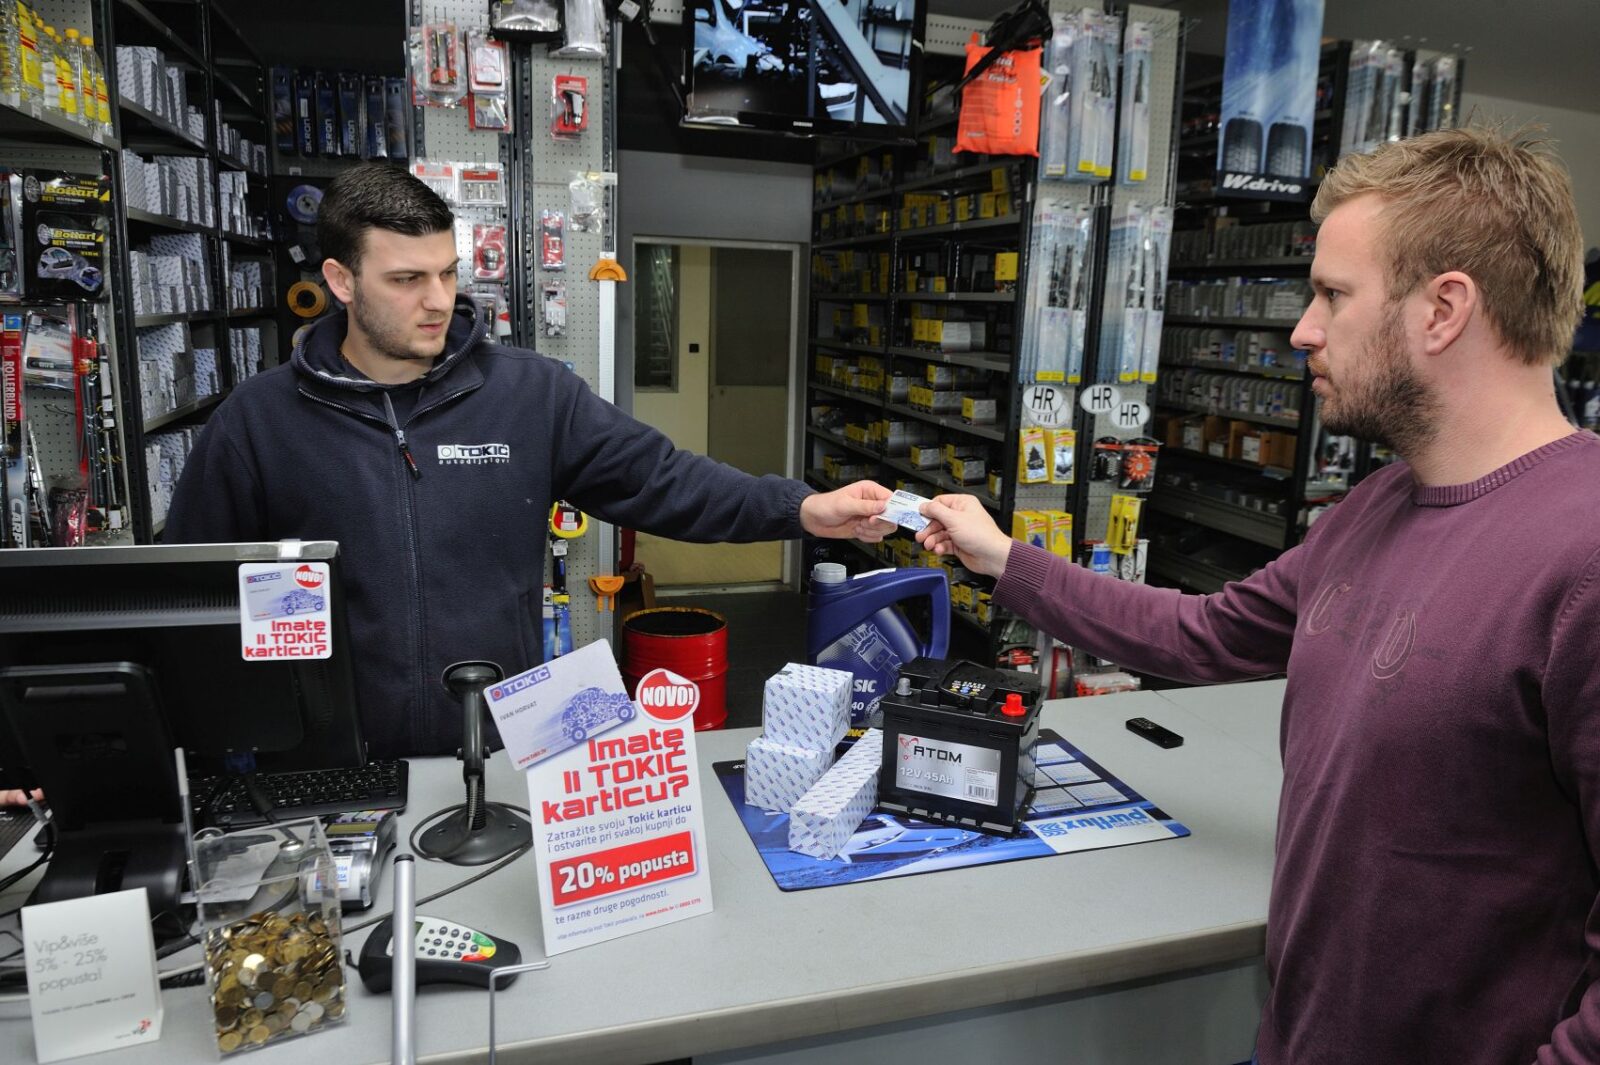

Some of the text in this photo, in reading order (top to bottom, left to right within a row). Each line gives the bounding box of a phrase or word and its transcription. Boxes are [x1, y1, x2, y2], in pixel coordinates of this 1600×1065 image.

[1223, 173, 1301, 194] W.drive
[54, 229, 96, 240] Bottari
[3, 360, 16, 419] ROLLERBLIND
[1032, 386, 1055, 411] HR
[1092, 387, 1112, 409] HR
[1120, 404, 1139, 425] HR
[271, 620, 326, 631] Imate
[245, 645, 327, 657] karticu?
[642, 686, 694, 707] NOVO!
[588, 728, 684, 762] Imate
[914, 745, 962, 763] ATOM
[900, 766, 922, 778] 12V
[924, 770, 954, 785] 45Ah
[542, 774, 689, 825] karticu?
[547, 803, 692, 843] Zatražite svoju Tokić karticu
[1062, 808, 1148, 831] purflux
[554, 836, 598, 852] ostvarite
[599, 831, 612, 845] pri
[614, 824, 644, 840] svakoj
[645, 817, 674, 832] kupnji
[675, 815, 687, 825] do
[559, 850, 689, 894] 20% popusta
[555, 915, 565, 925] te
[567, 907, 592, 922] razne
[593, 900, 618, 914] druge
[620, 888, 670, 909] pogodnosti.
[35, 957, 58, 973] 5%
[73, 947, 107, 967] 25%
